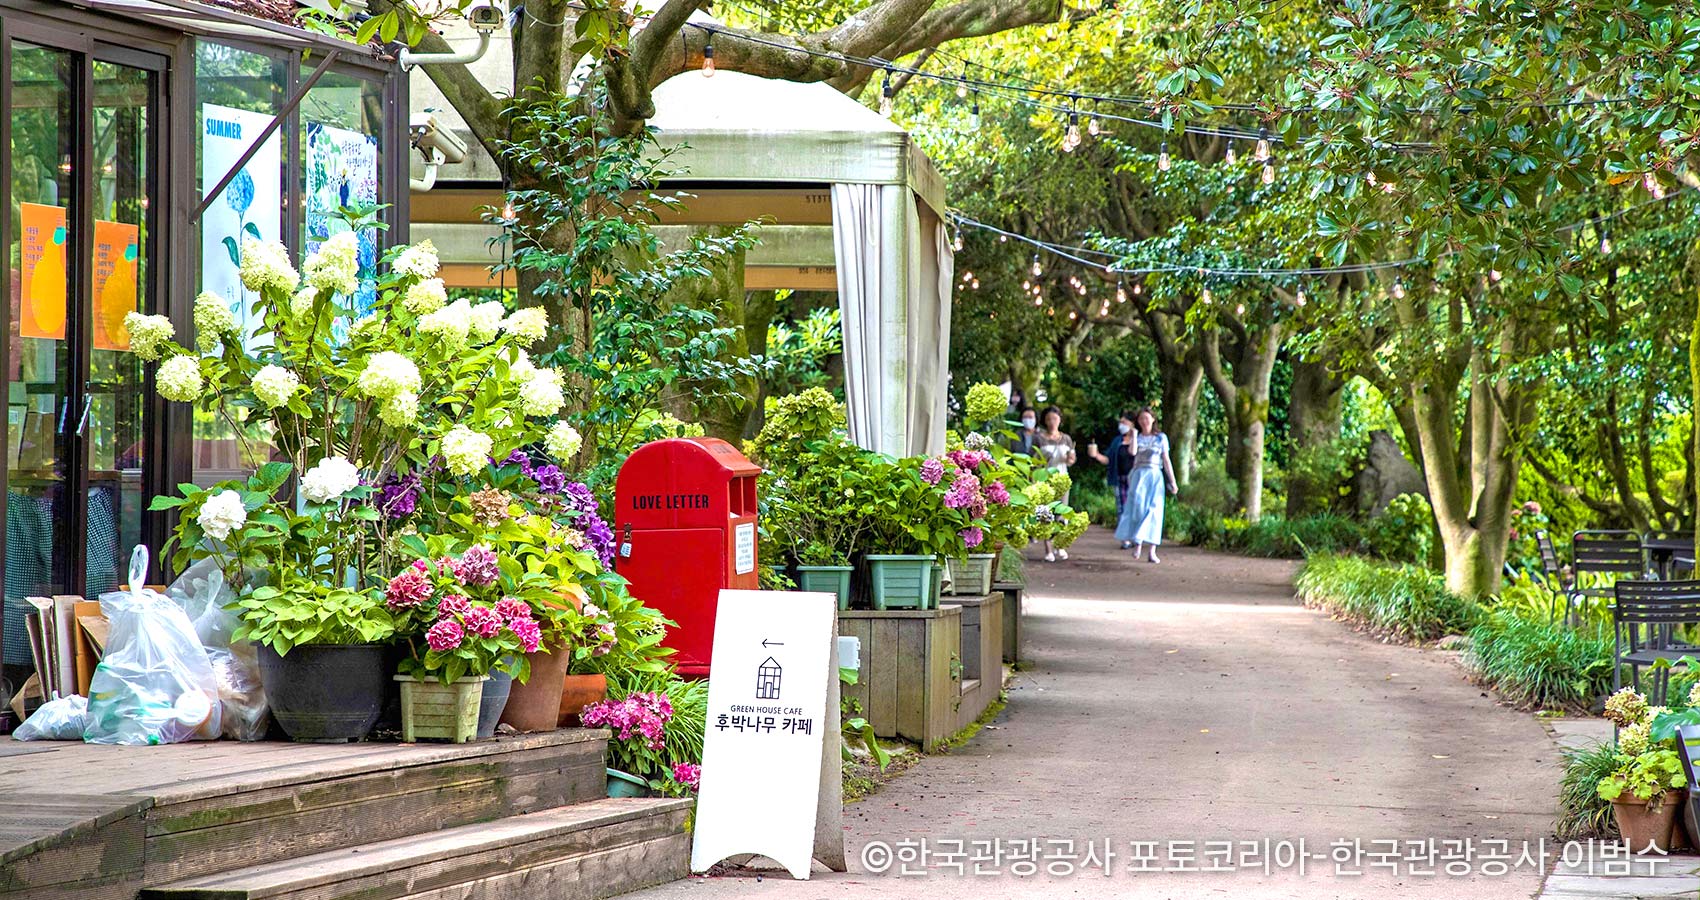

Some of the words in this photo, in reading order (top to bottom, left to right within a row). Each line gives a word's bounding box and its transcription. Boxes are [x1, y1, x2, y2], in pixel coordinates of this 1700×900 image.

[206, 118, 242, 140] SUMMER
[633, 495, 662, 510] LOVE
[666, 494, 709, 509] LETTER
[730, 704, 755, 713] GREEN
[756, 706, 782, 715] HOUSE
[783, 707, 803, 716] CAFE
[714, 713, 777, 734] 후박나무
[781, 717, 813, 736] 카페
